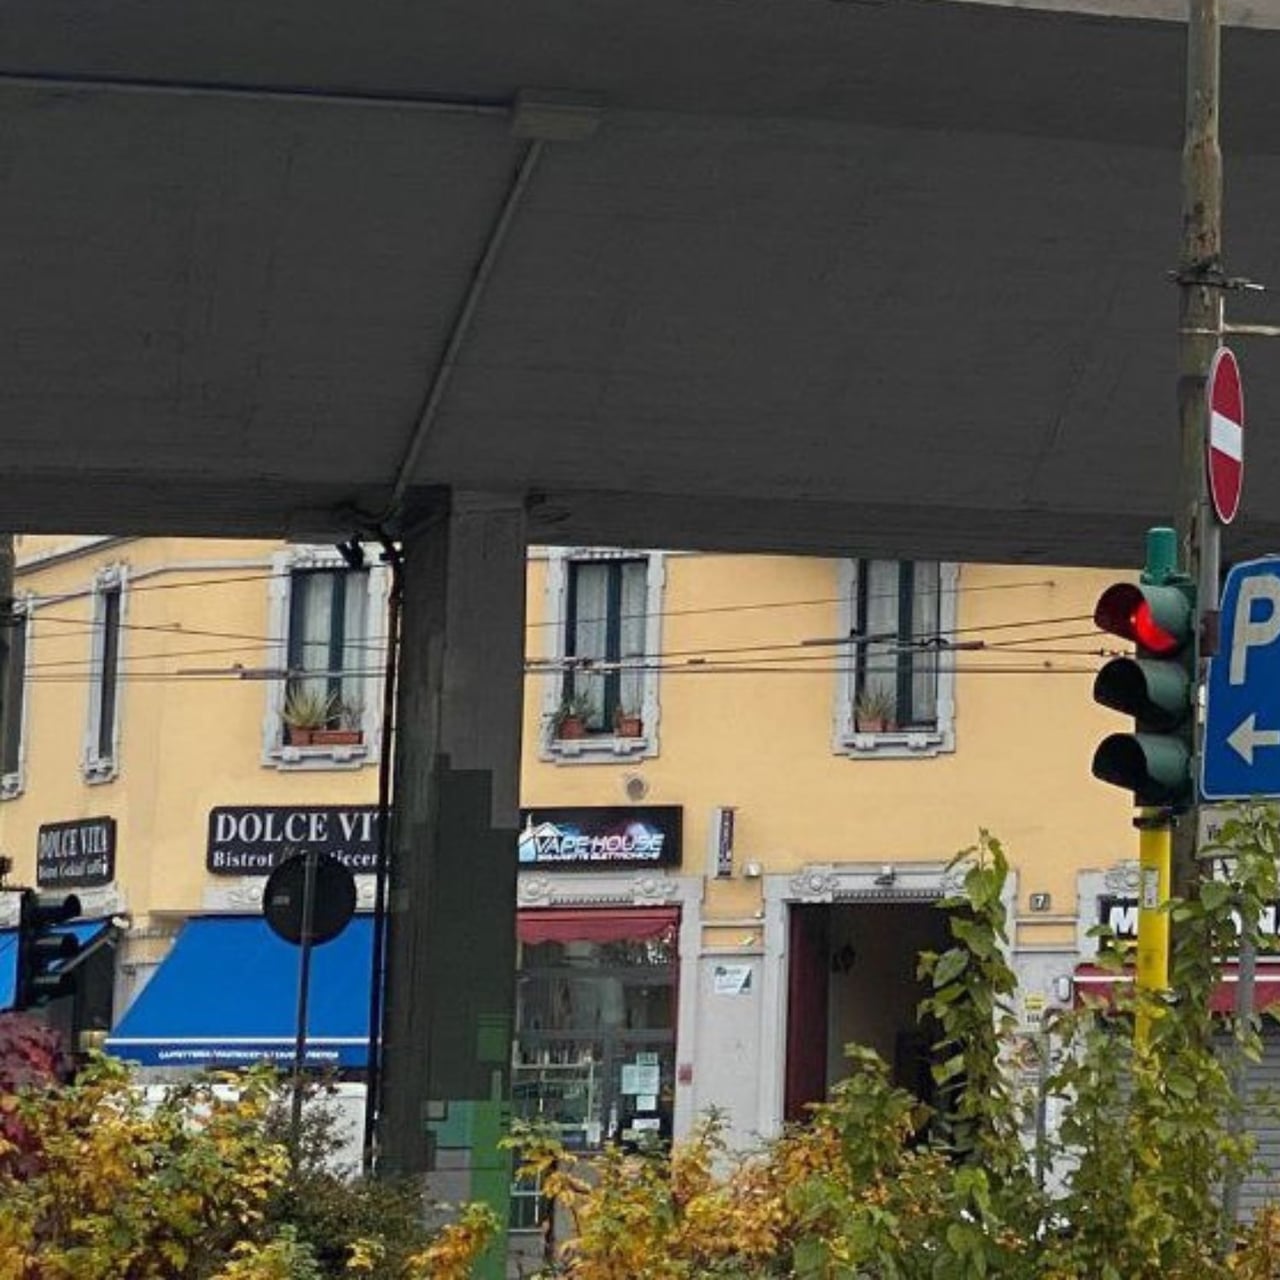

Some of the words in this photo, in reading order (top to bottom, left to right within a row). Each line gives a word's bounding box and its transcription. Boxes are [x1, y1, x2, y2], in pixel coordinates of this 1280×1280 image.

[215, 812, 328, 842] DOLCE
[338, 811, 378, 842] VI
[536, 834, 590, 853] VAPE
[591, 833, 664, 851] HOUSE
[213, 850, 274, 868] Bistrot
